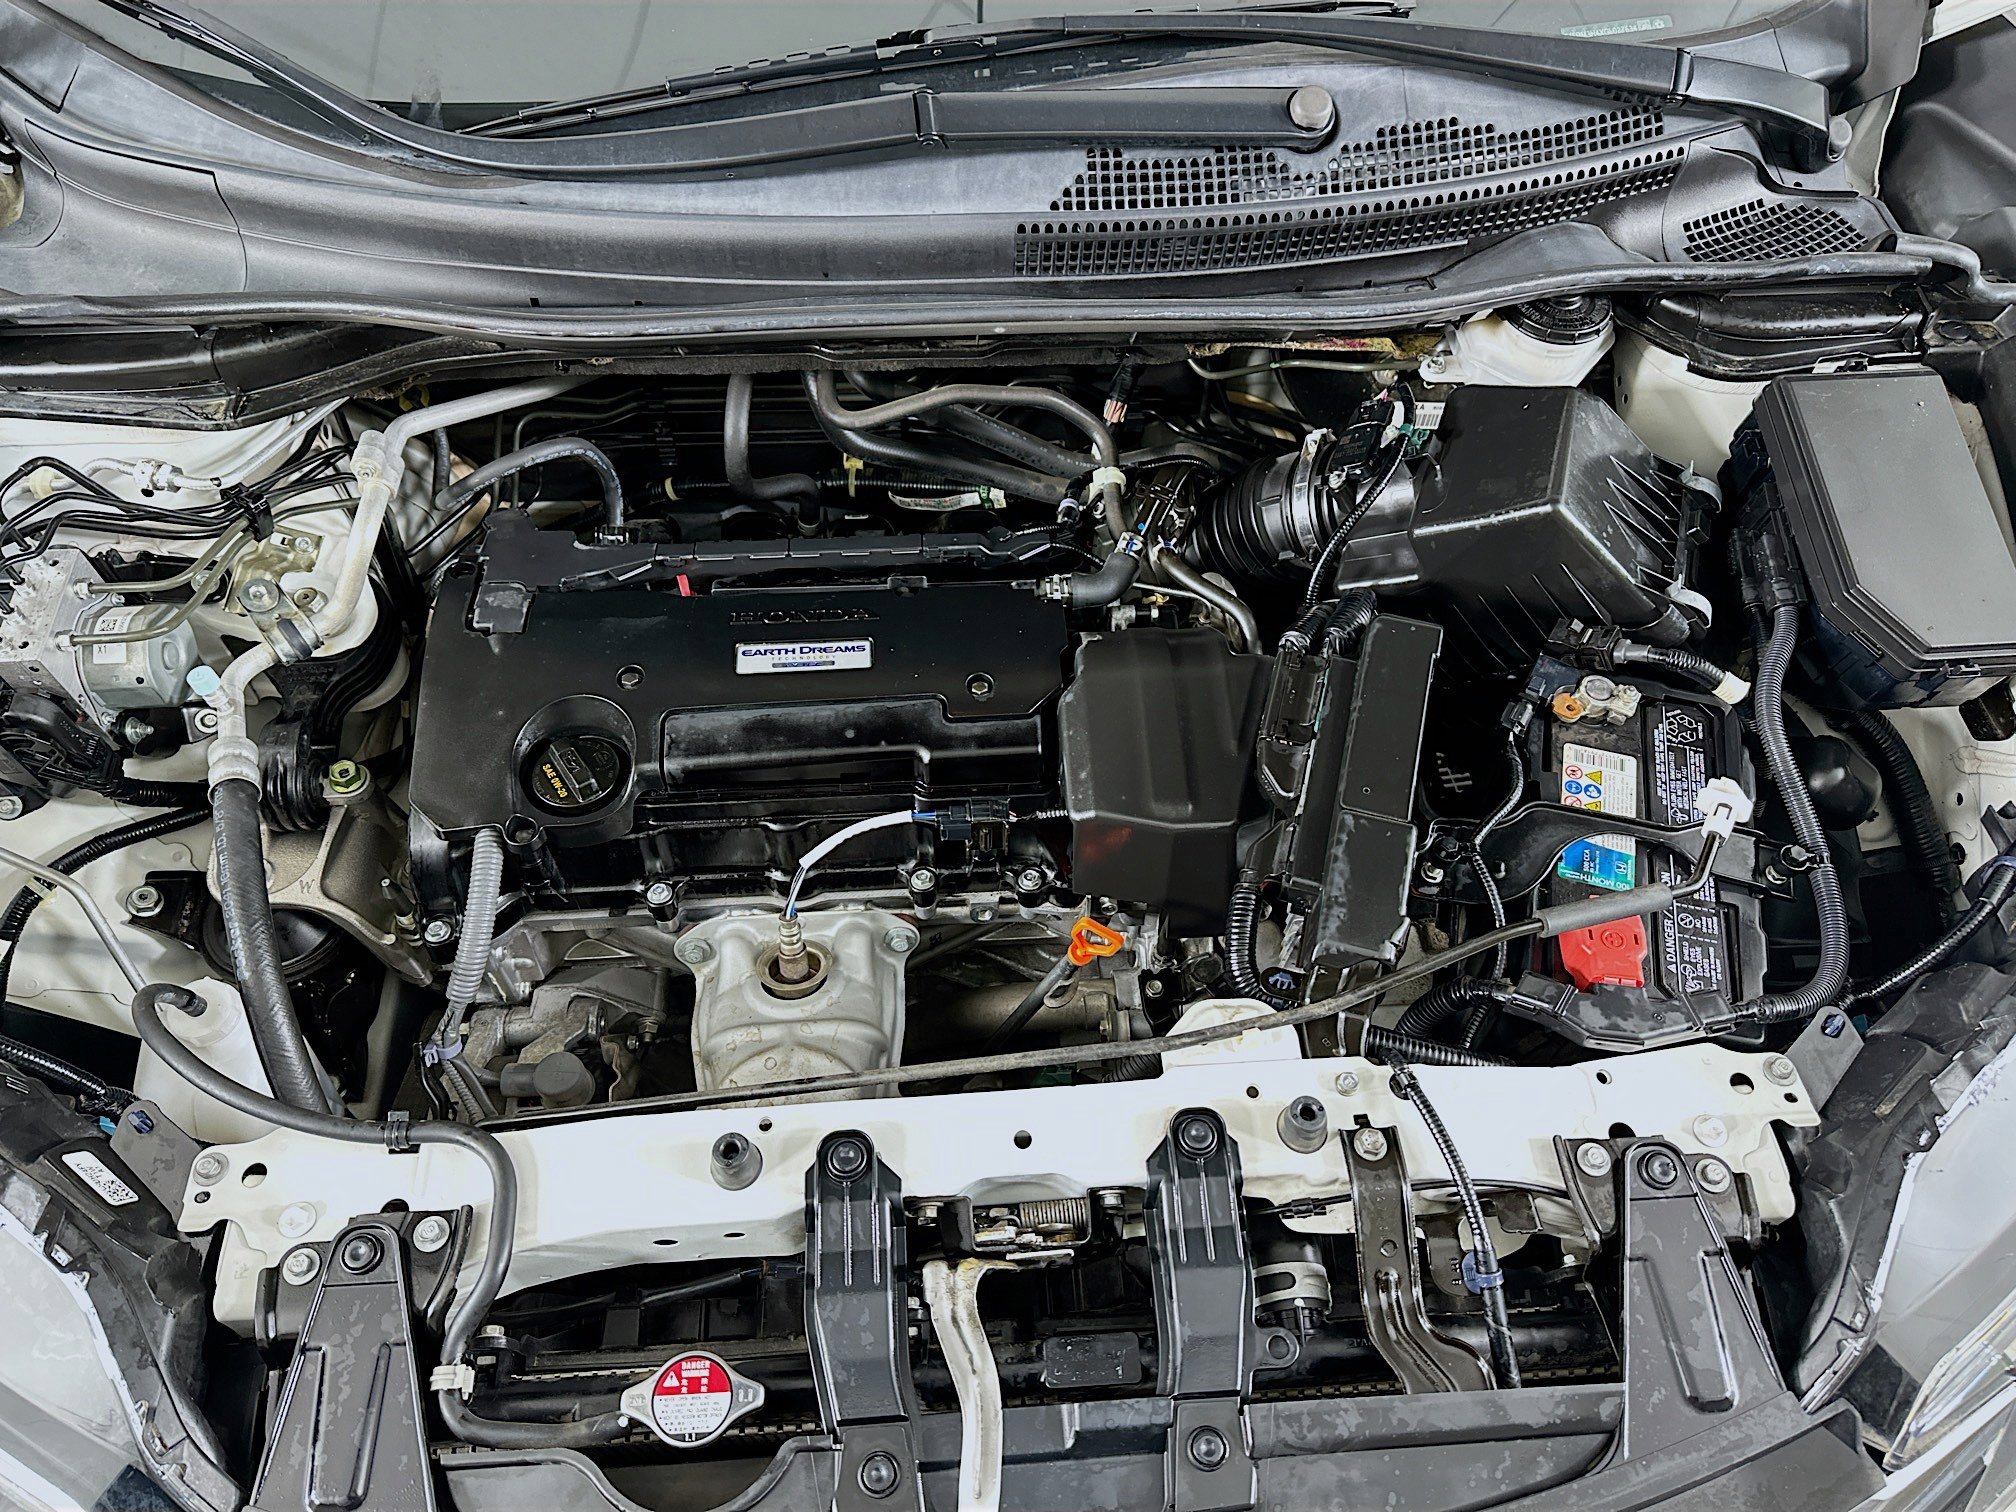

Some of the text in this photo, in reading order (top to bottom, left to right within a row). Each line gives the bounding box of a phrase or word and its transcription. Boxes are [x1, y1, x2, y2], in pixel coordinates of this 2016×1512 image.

[728, 609, 880, 625] HONDA
[97, 645, 107, 655] X1
[741, 645, 866, 657] EARTH DREAMS
[543, 763, 557, 779] SAE
[551, 777, 568, 798] 0W-20
[217, 833, 227, 851] I.D.
[218, 852, 231, 886] 16mm
[300, 879, 315, 894] W
[1580, 873, 1630, 890] 100 MONTH
[221, 887, 235, 919] 2041
[1695, 919, 1701, 928] NO
[1695, 946, 1703, 976] EXPLOSIVE
[681, 1360, 711, 1370] DANGER
[738, 1388, 753, 1402] 1.1
[684, 1433, 696, 1442] 1.1
